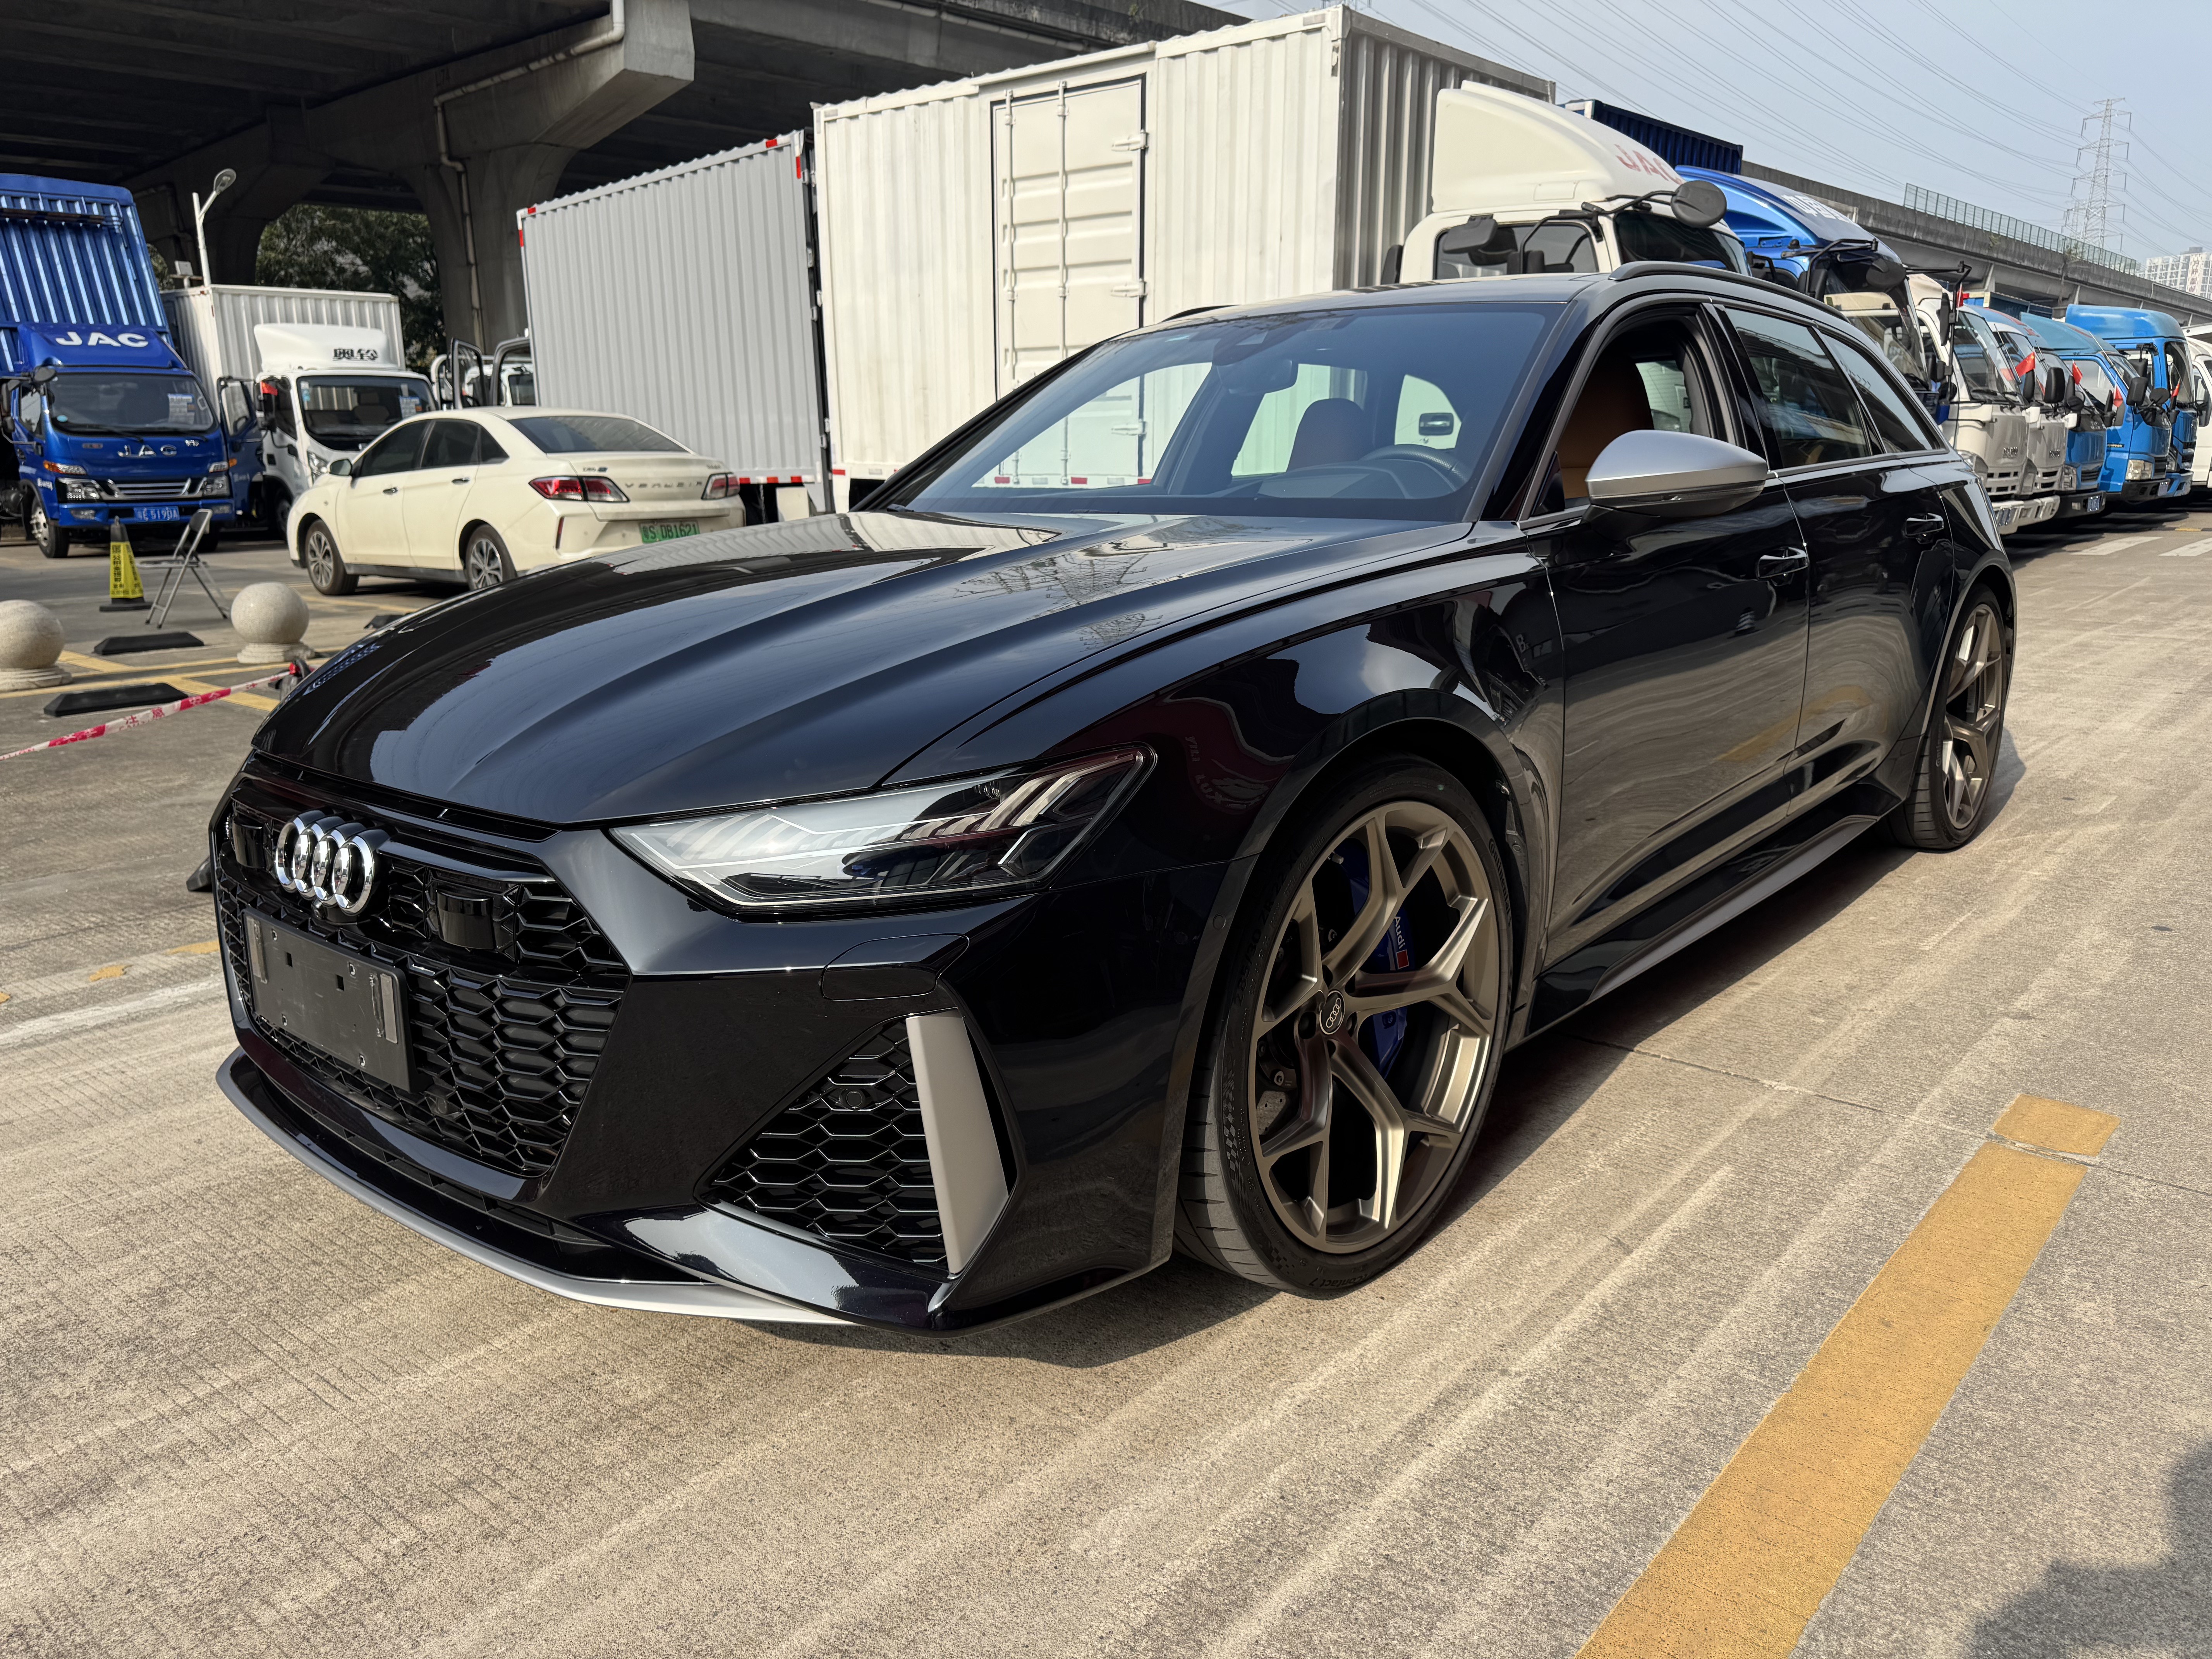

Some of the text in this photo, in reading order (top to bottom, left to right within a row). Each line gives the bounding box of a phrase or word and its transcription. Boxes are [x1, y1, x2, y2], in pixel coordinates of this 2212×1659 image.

[1614, 144, 1683, 185] JAC
[55, 331, 149, 348] JAC
[117, 445, 177, 457] JAC
[1394, 916, 1405, 949] Audi
